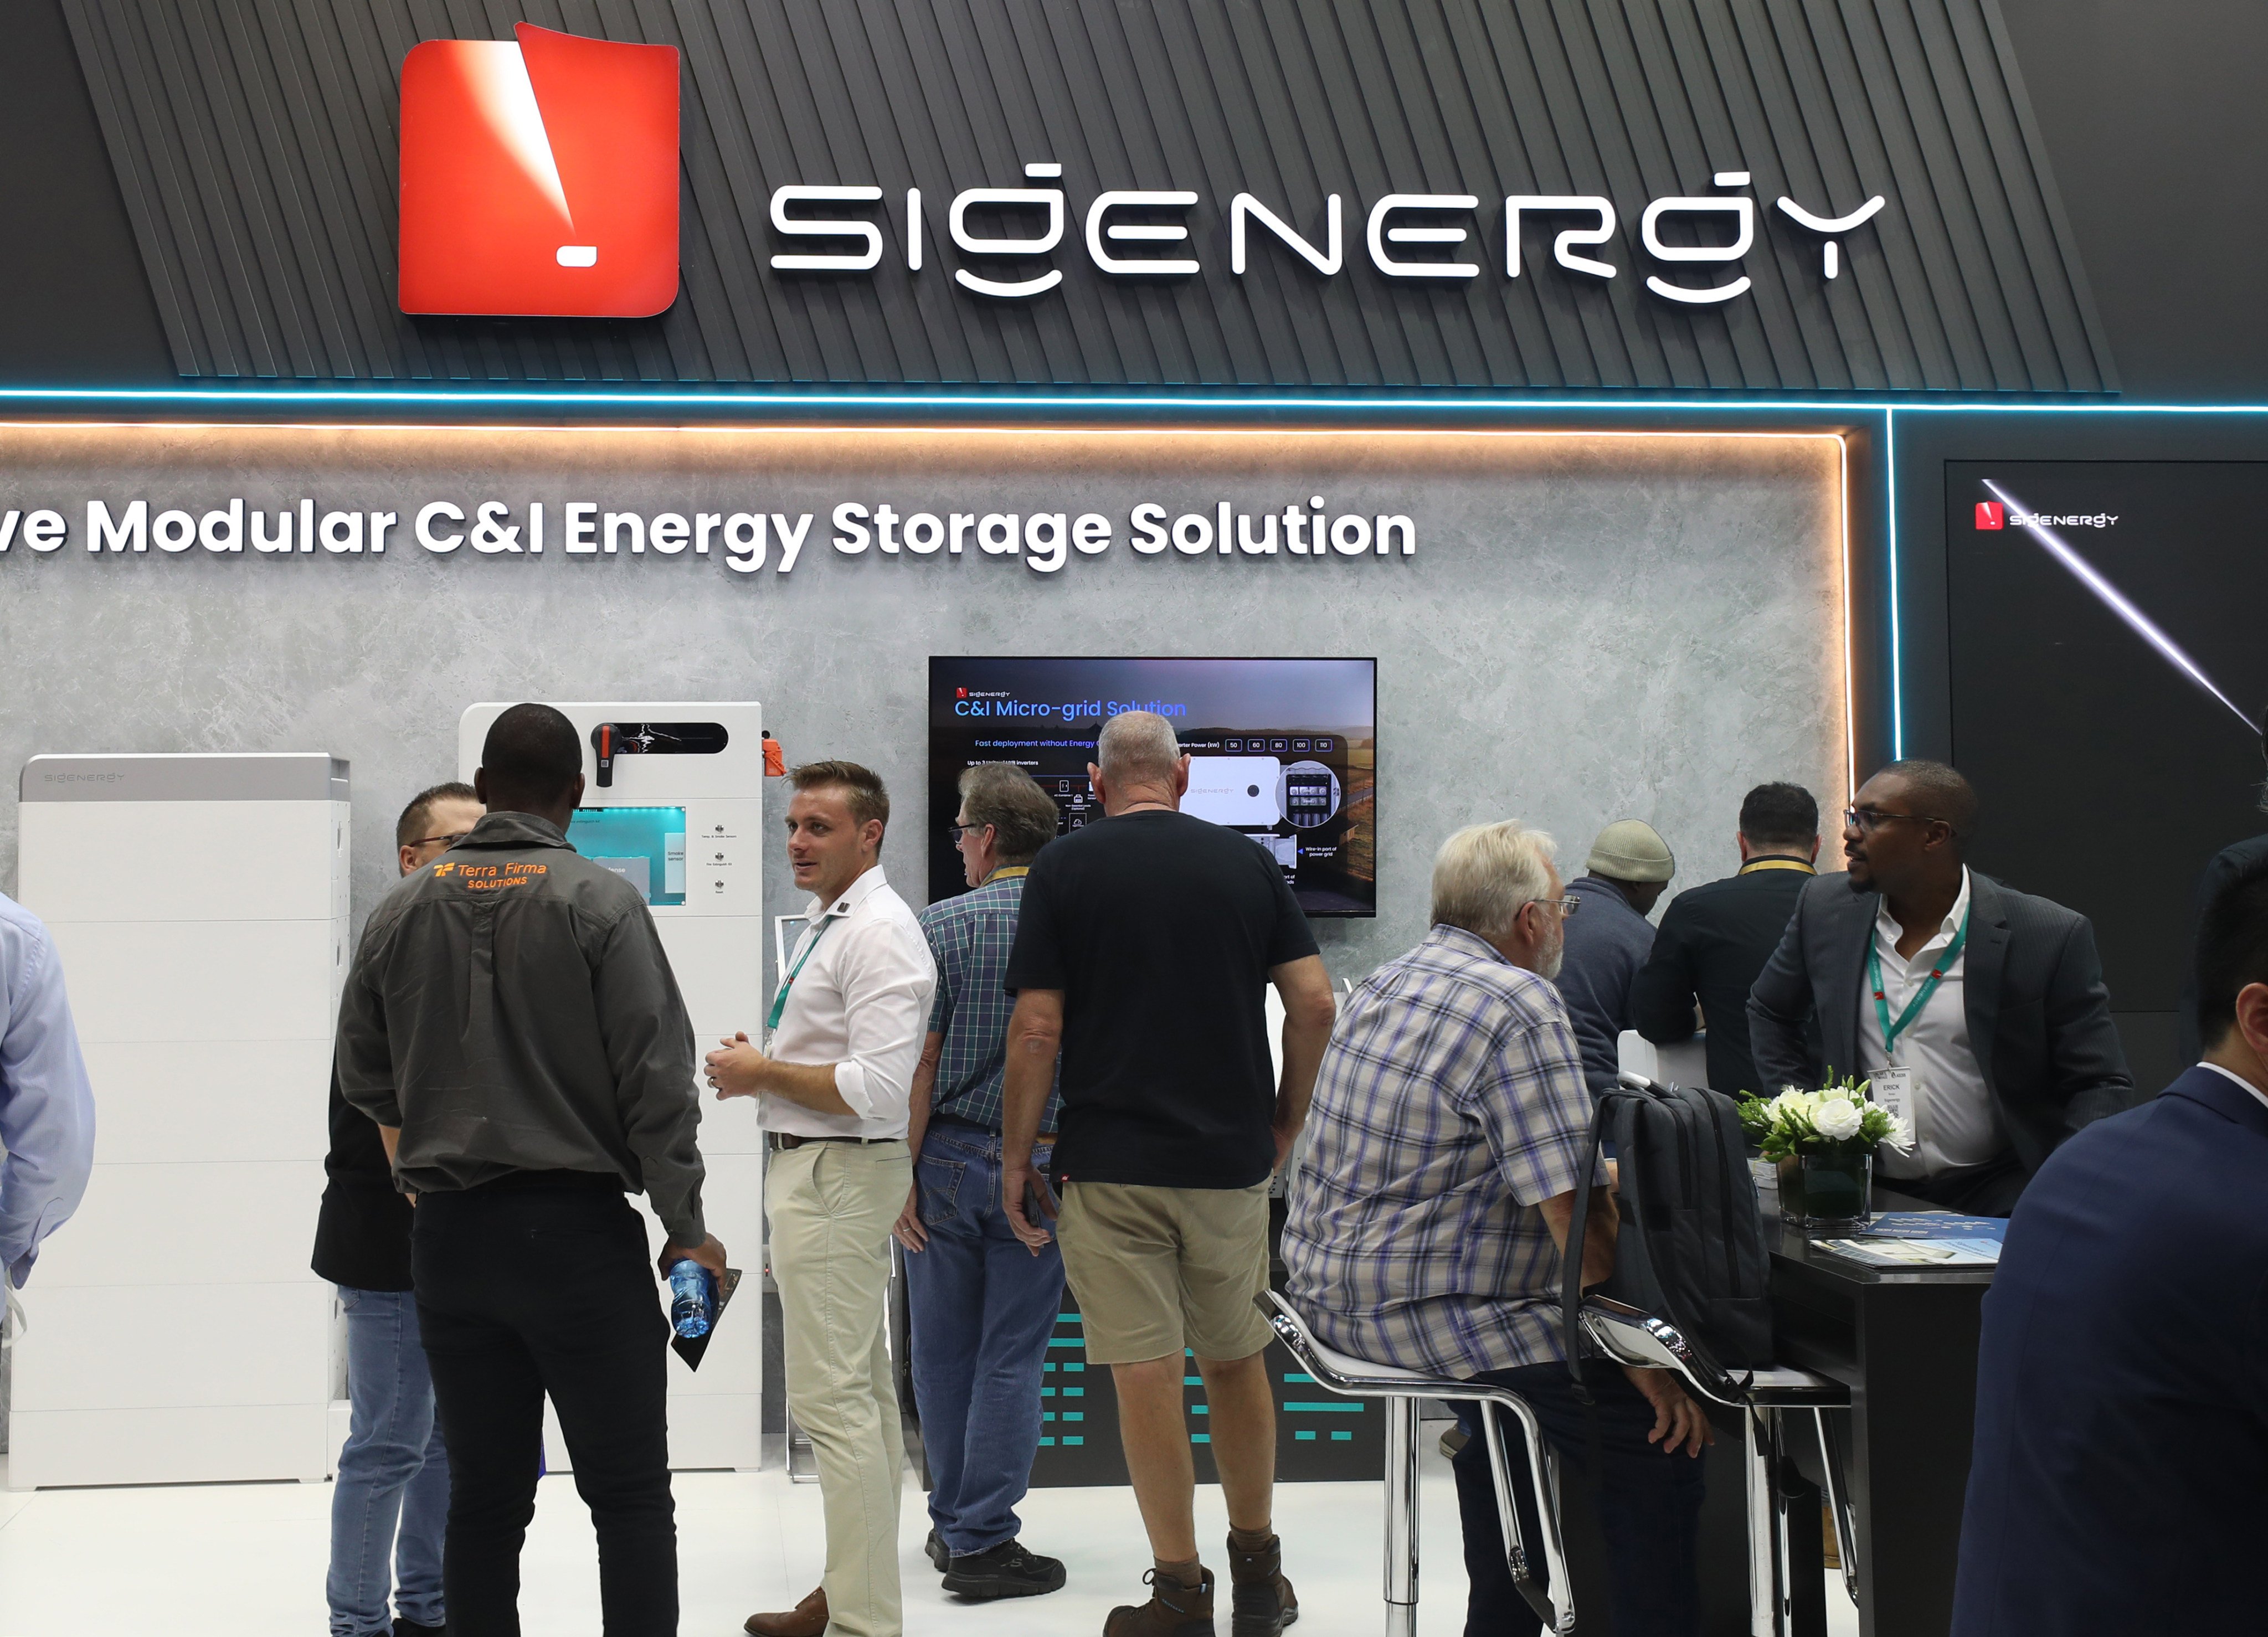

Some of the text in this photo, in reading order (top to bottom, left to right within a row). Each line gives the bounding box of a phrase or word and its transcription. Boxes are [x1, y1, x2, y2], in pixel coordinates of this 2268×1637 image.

[87, 498, 398, 554] Modular
[415, 501, 544, 554] C&I
[565, 502, 814, 573] Energy
[832, 502, 1112, 573] Storage
[1130, 495, 1416, 555] Solution
[955, 700, 990, 717] C&I
[996, 699, 1101, 722] Micro-grid
[992, 740, 1038, 749] deployment
[1069, 740, 1096, 749] Energy
[457, 864, 497, 877] Terra
[505, 862, 547, 876] Firma
[467, 876, 528, 889] SOLUTIONS
